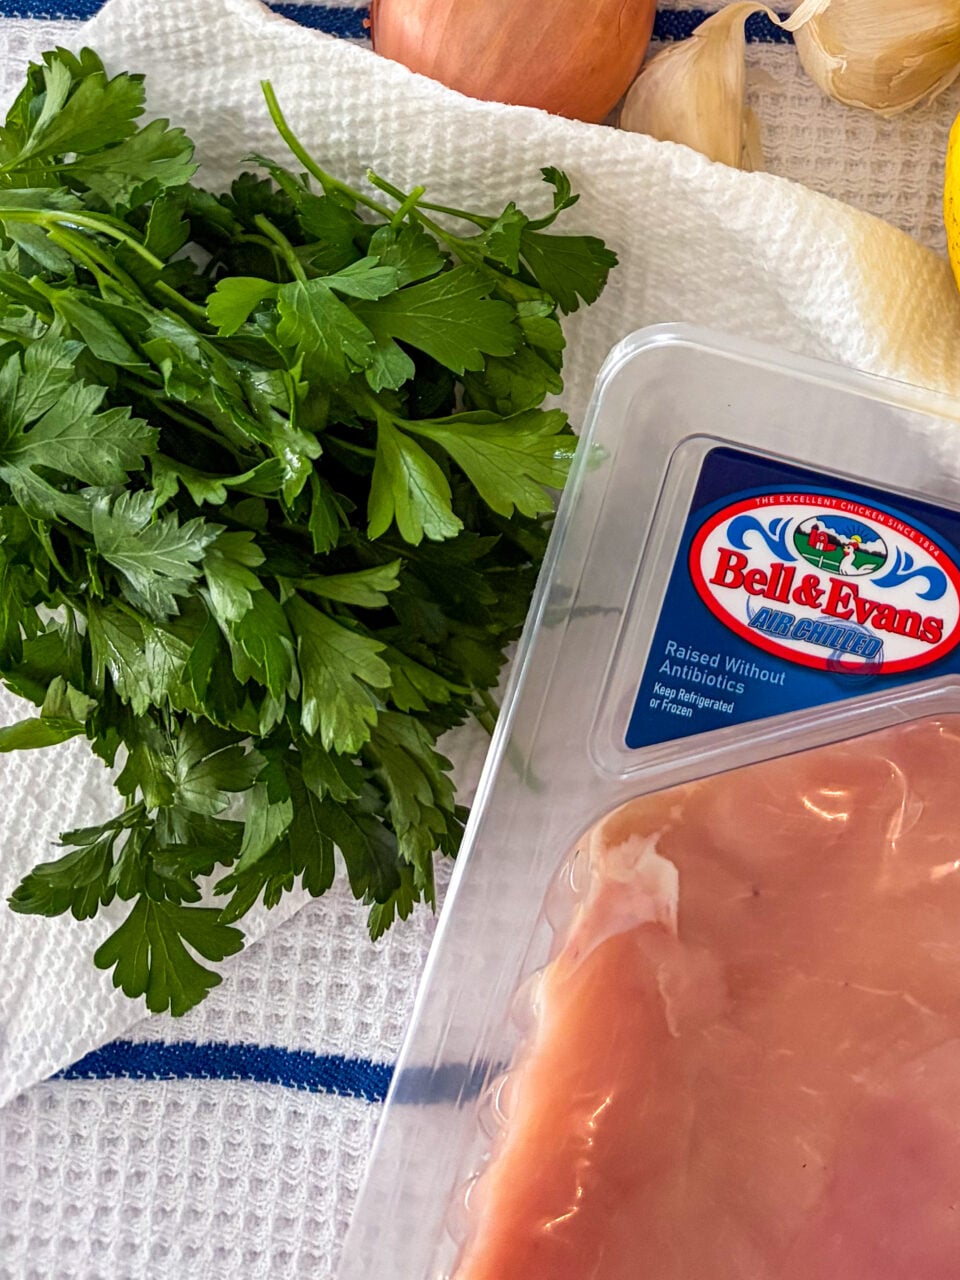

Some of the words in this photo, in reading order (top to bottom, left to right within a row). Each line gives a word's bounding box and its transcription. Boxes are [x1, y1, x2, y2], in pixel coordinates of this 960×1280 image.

[755, 496, 775, 507] THE
[779, 495, 837, 508] EXCELLENT
[840, 501, 885, 522] CHICKEN
[887, 518, 916, 539] SINCE
[918, 536, 941, 558] 1894
[748, 606, 790, 638] AIR
[791, 616, 885, 659] CHILLED
[659, 658, 746, 695] Antibiotics
[664, 640, 720, 669] Raised
[724, 654, 786, 687] Without
[649, 698, 660, 710] or
[661, 699, 693, 719] Frozen
[653, 681, 678, 700] Keep
[677, 686, 735, 715] Refrigerated
